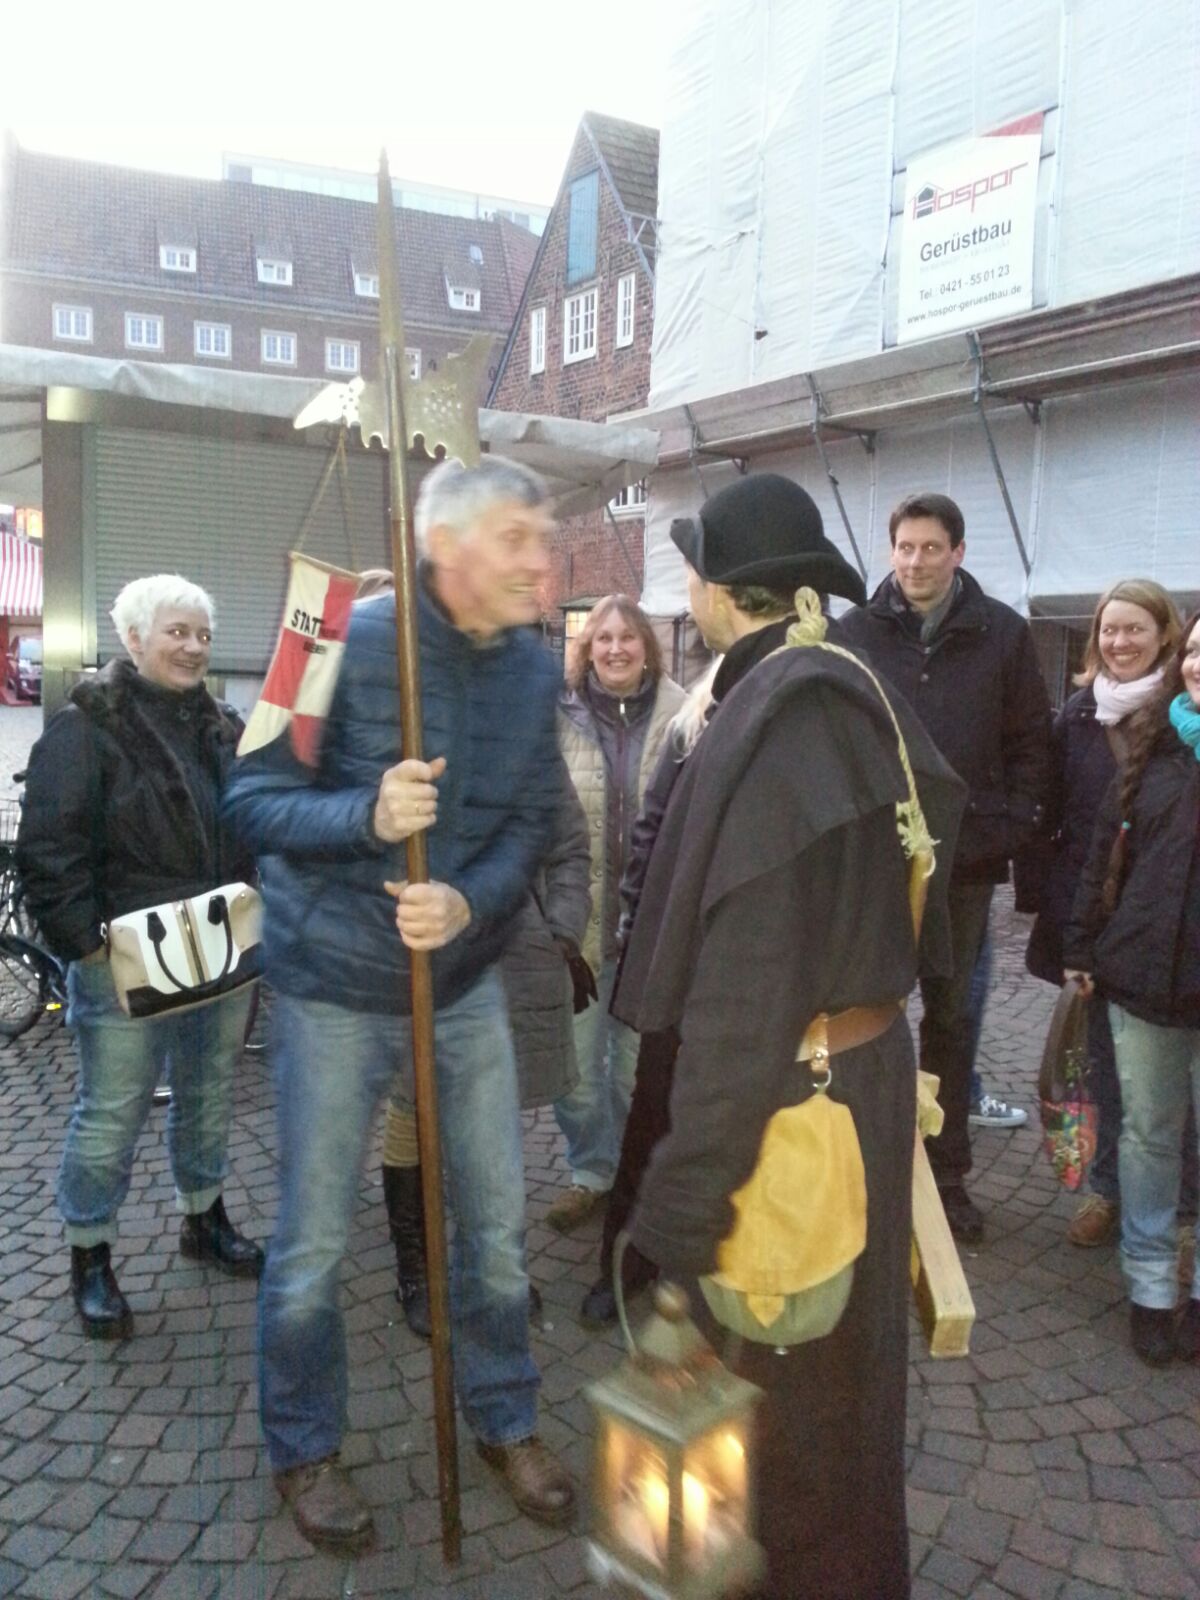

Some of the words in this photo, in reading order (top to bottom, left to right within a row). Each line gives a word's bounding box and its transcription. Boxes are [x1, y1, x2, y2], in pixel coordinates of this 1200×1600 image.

[919, 219, 1012, 262] Gerüstbau
[907, 284, 1022, 324] www.hospor-geruestbau.de
[939, 278, 962, 295] 0421
